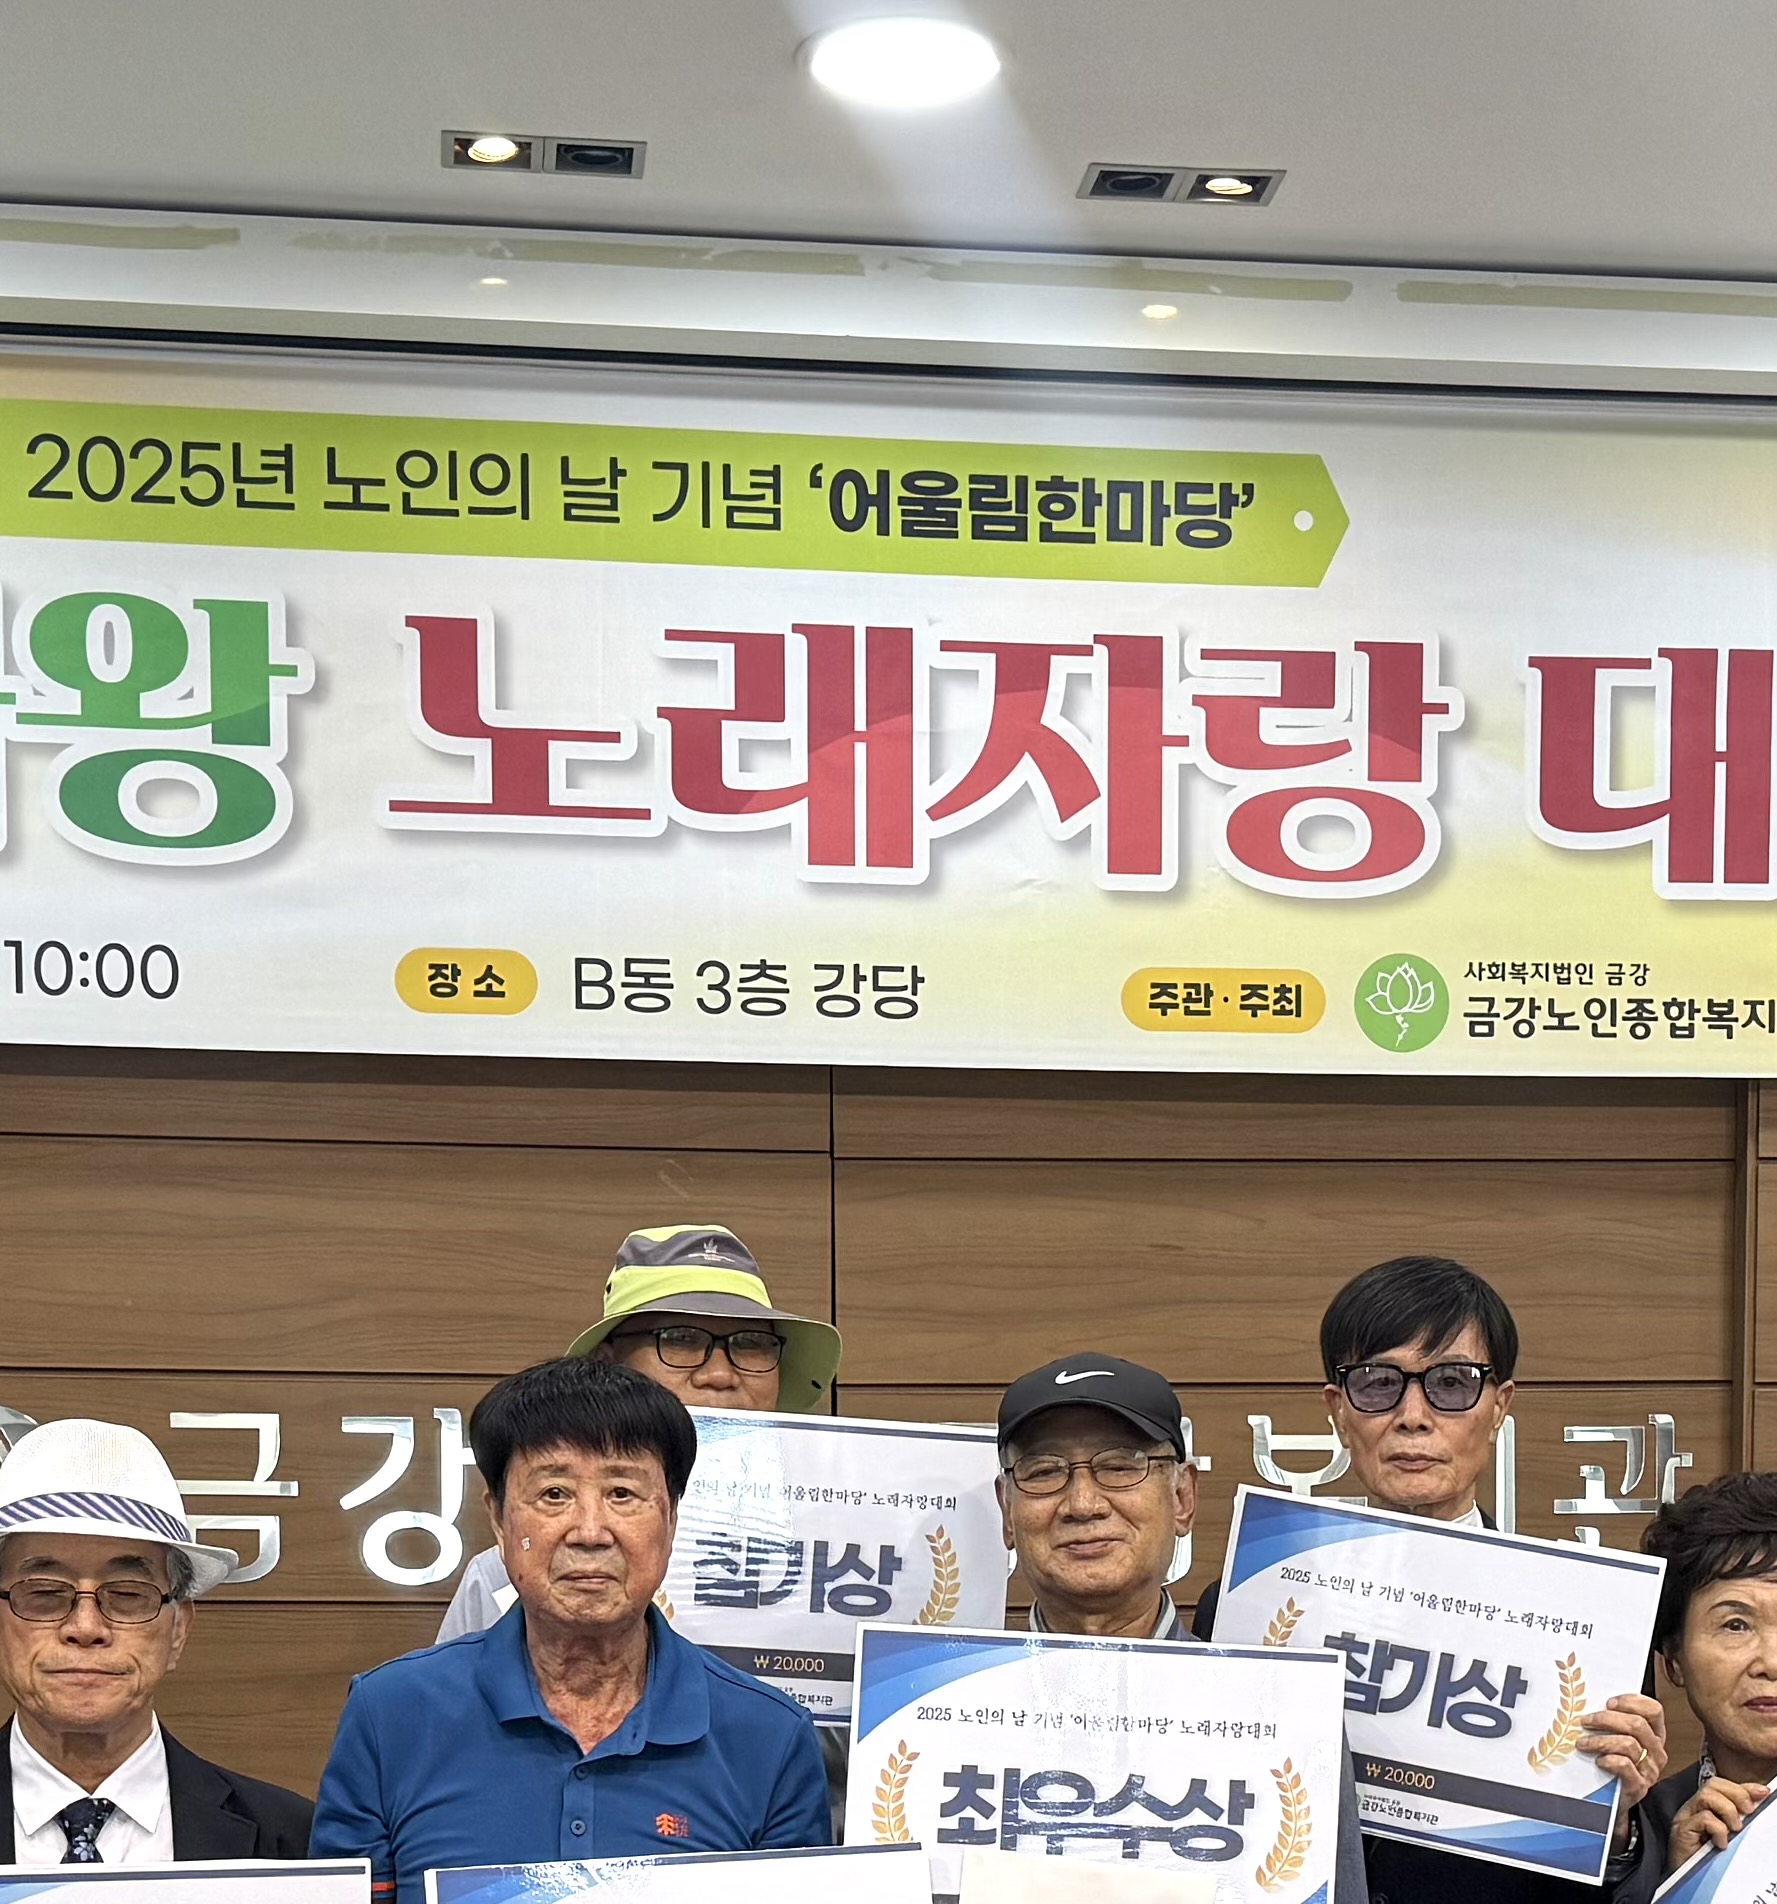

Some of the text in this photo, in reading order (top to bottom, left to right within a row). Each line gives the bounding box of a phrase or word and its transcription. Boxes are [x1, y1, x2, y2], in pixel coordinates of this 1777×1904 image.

[26, 434, 295, 511] 2025년
[324, 447, 530, 520] 노인의
[561, 455, 627, 523] 날
[652, 460, 783, 532] 기념
[387, 614, 1450, 883] 노래자랑
[3, 938, 180, 1000] 10:00
[574, 957, 926, 1020] B동 3층 강당
[1463, 960, 1651, 987] 사회복지법인 금강
[693, 1532, 903, 1617] 참가상
[1280, 1566, 1311, 1584] 2025
[1314, 1572, 1355, 1593] 노인의
[916, 1705, 952, 1722] 2025
[957, 1707, 1004, 1726] 노인의
[1324, 1631, 1528, 1740] 참가상
[937, 1765, 1256, 1863] 최우수상
